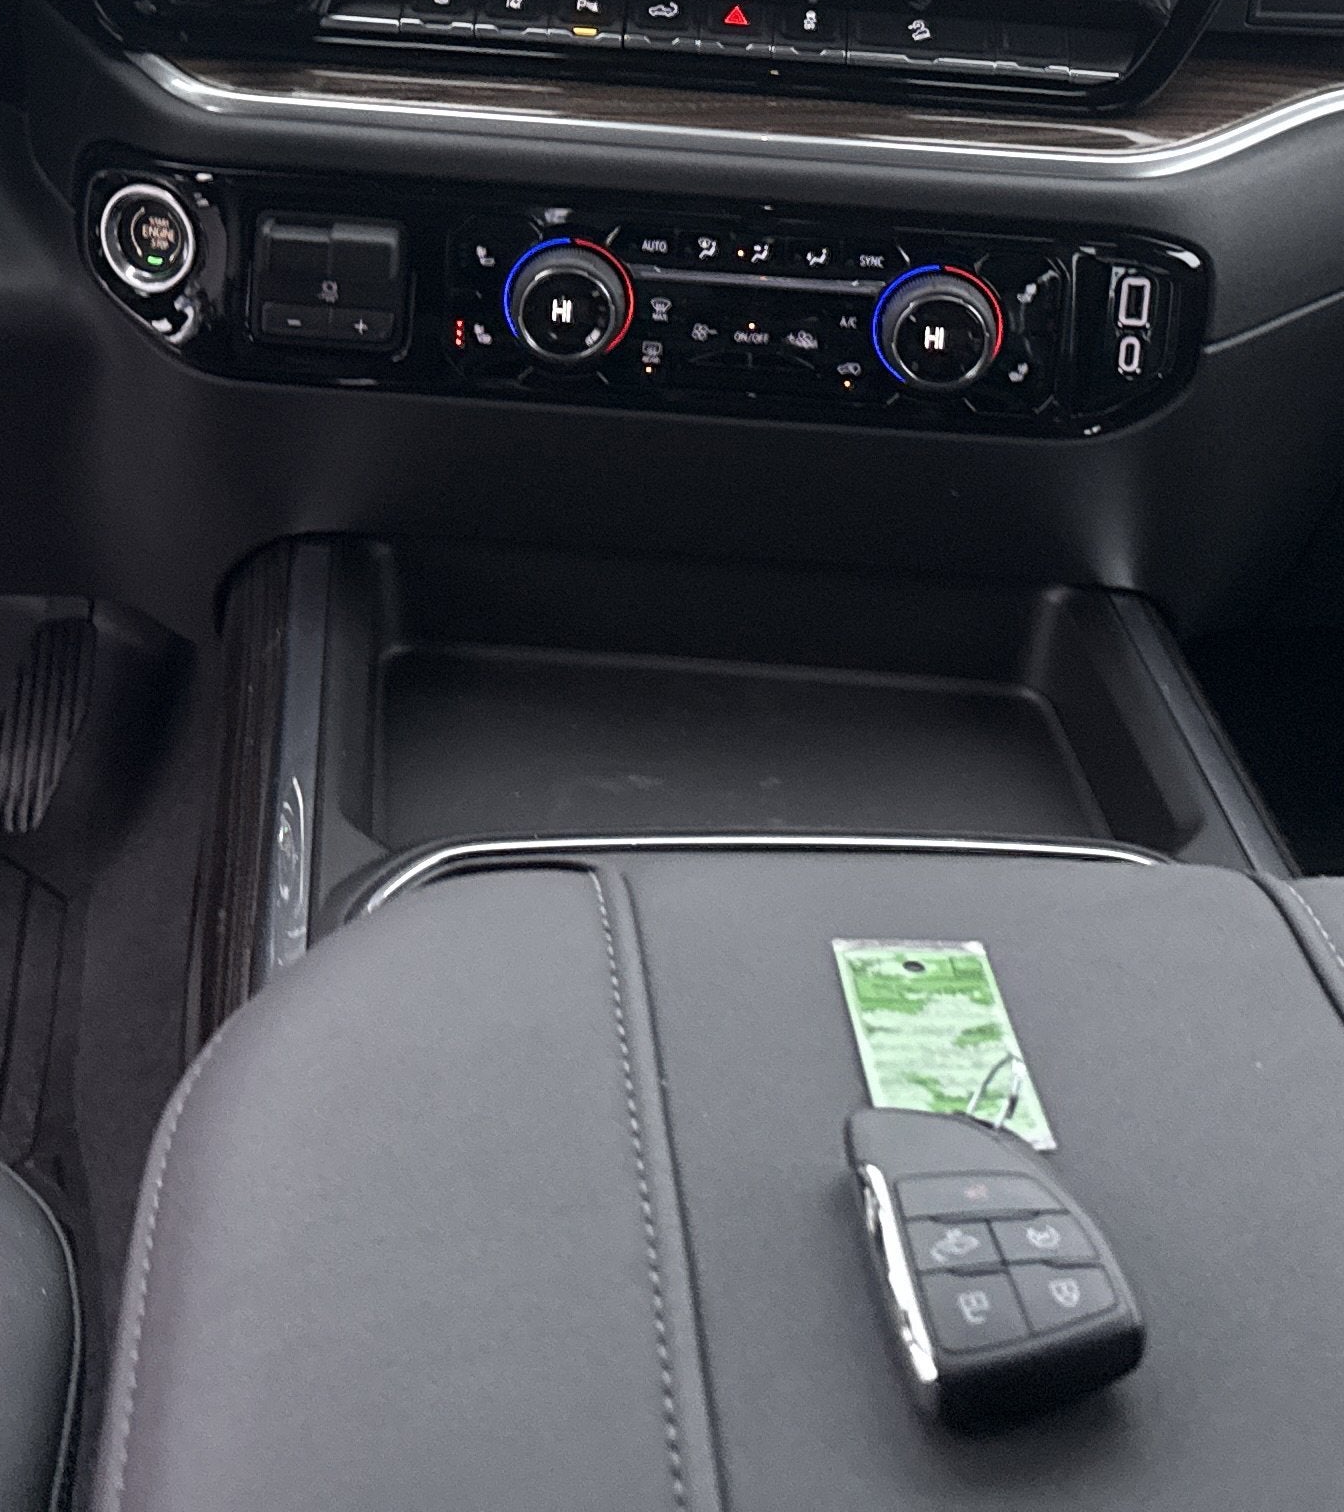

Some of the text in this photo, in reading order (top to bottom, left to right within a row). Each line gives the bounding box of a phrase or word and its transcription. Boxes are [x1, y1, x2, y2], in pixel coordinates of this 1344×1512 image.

[641, 239, 668, 254] AUTO
[859, 254, 886, 269] SYNC
[551, 298, 573, 323] HI
[839, 315, 857, 330] A/C
[733, 330, 770, 345] ON/OFF
[923, 325, 945, 350] HI
